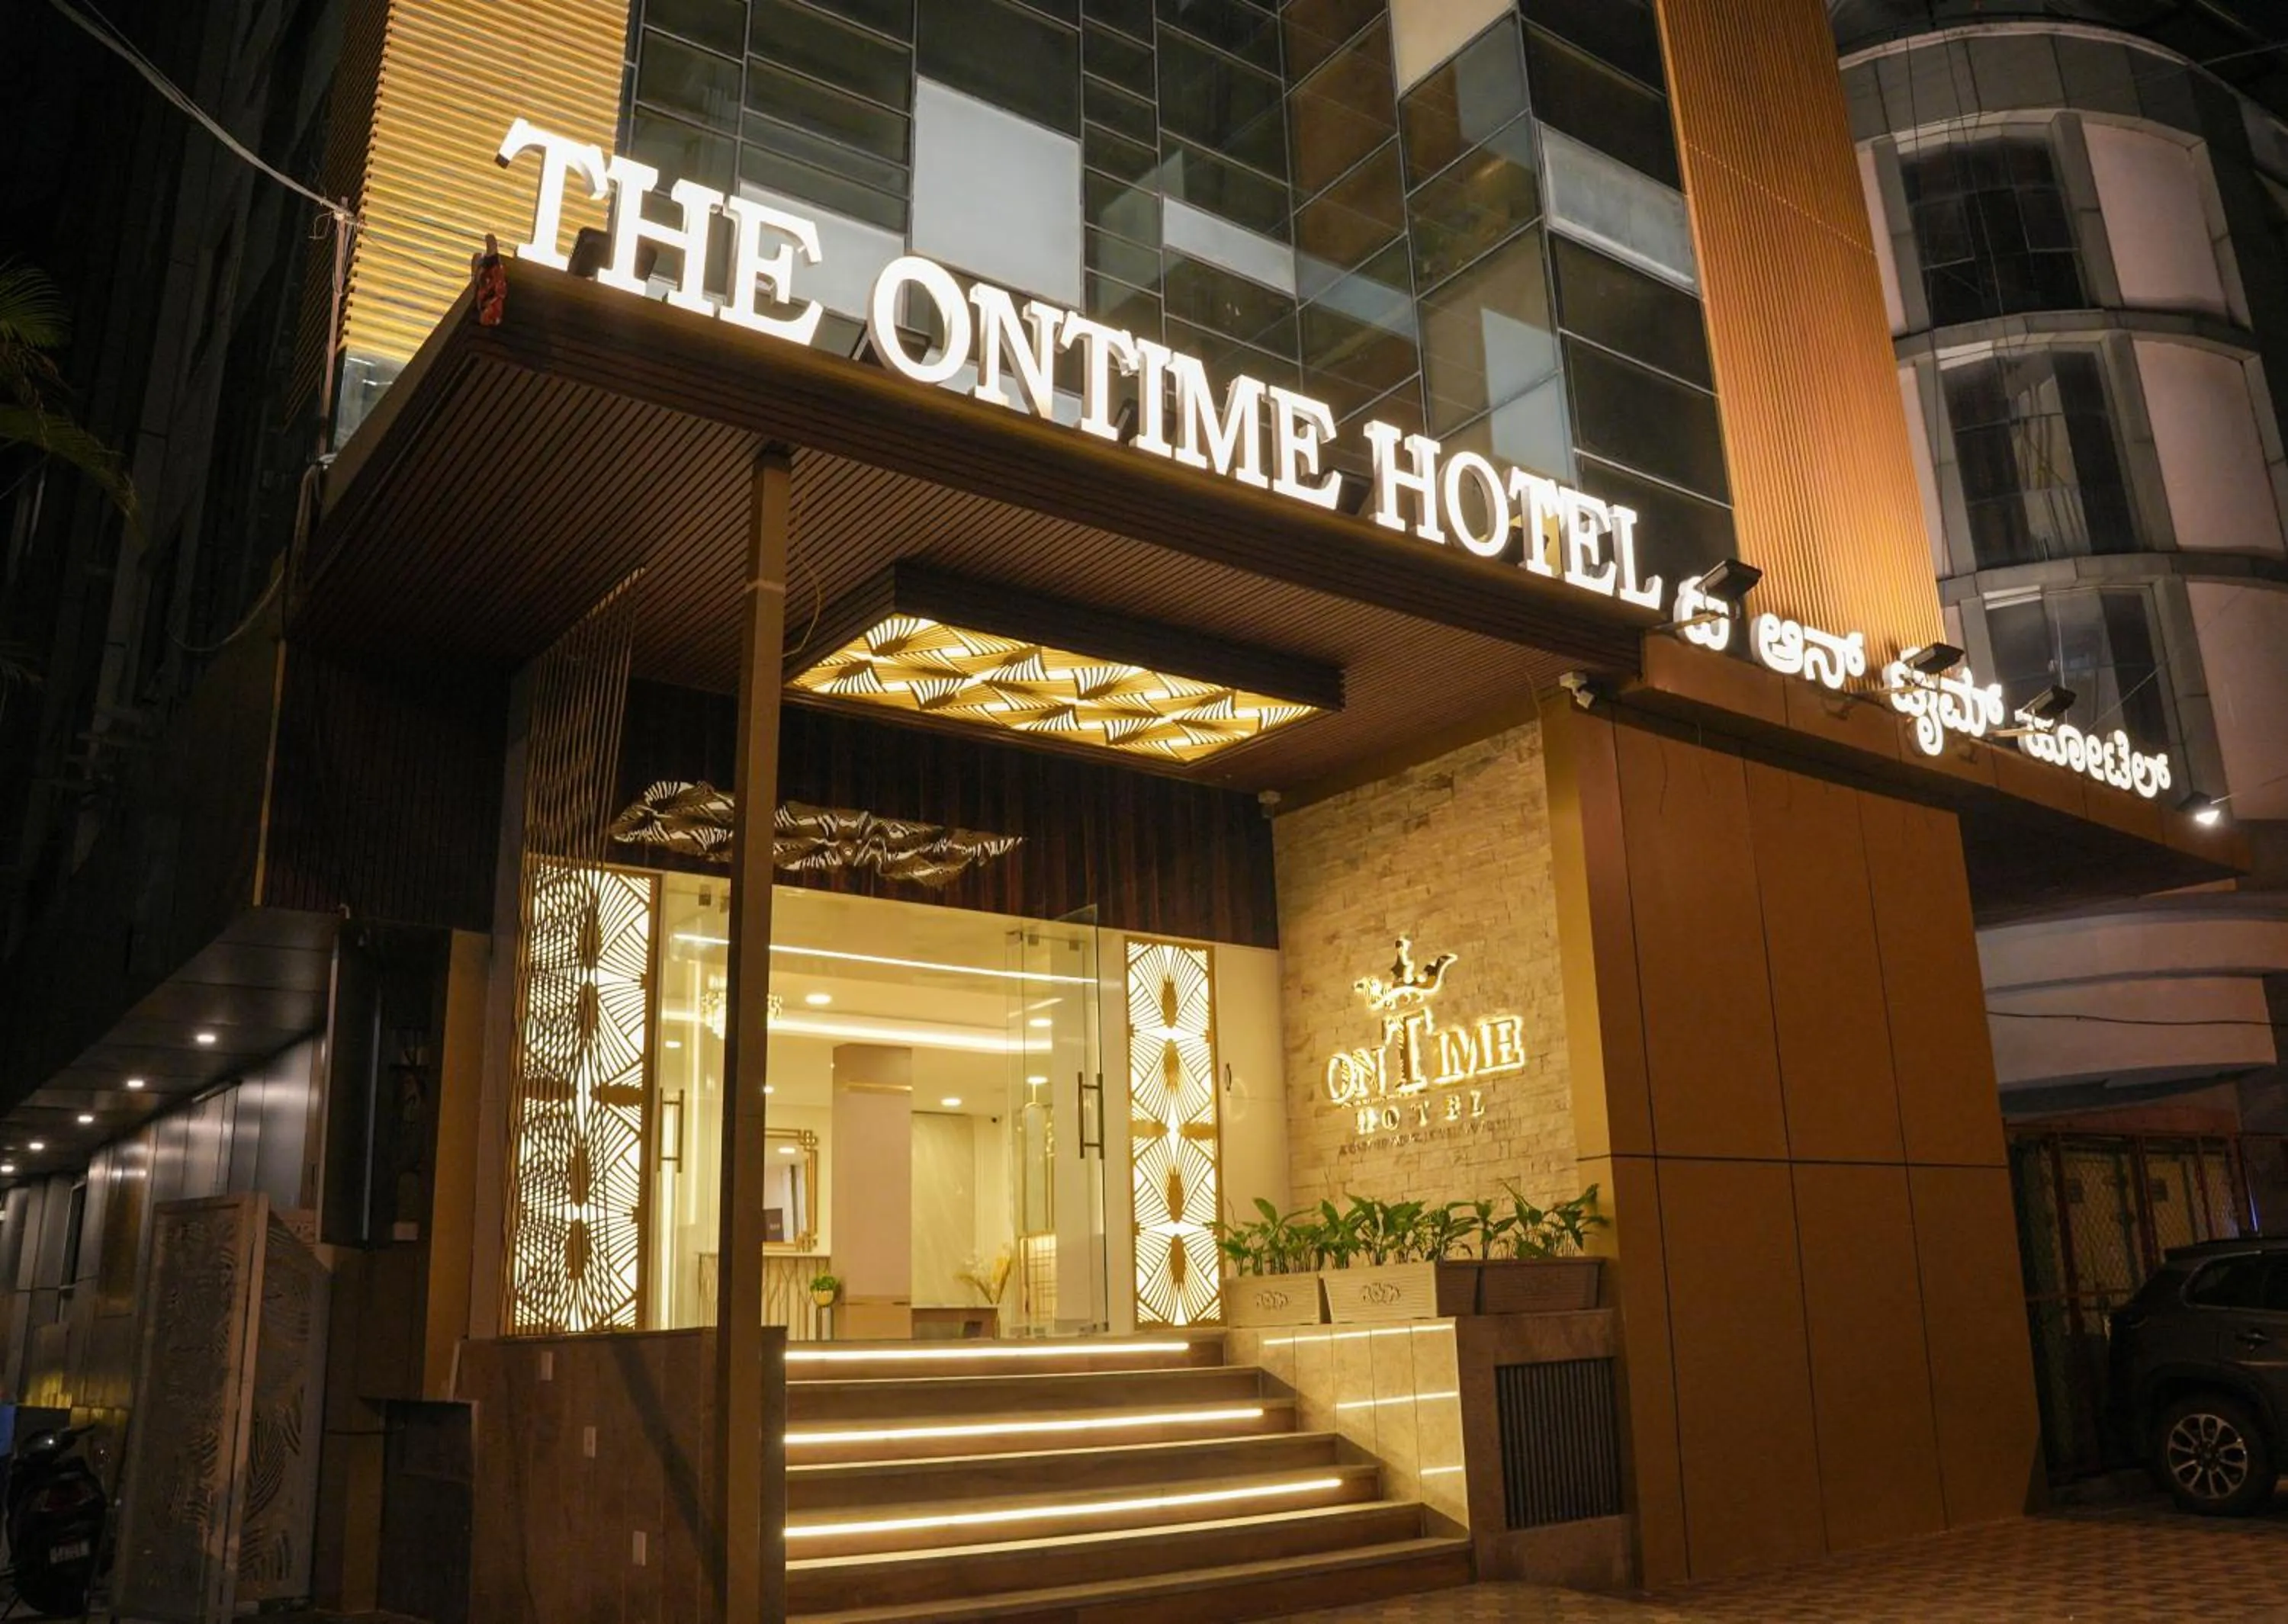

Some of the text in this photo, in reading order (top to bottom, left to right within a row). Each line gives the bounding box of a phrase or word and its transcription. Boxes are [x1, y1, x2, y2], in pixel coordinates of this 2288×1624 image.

[494, 117, 1663, 609] THE ONTIME HOTEL
[1355, 1090, 1486, 1135] HOTEL
